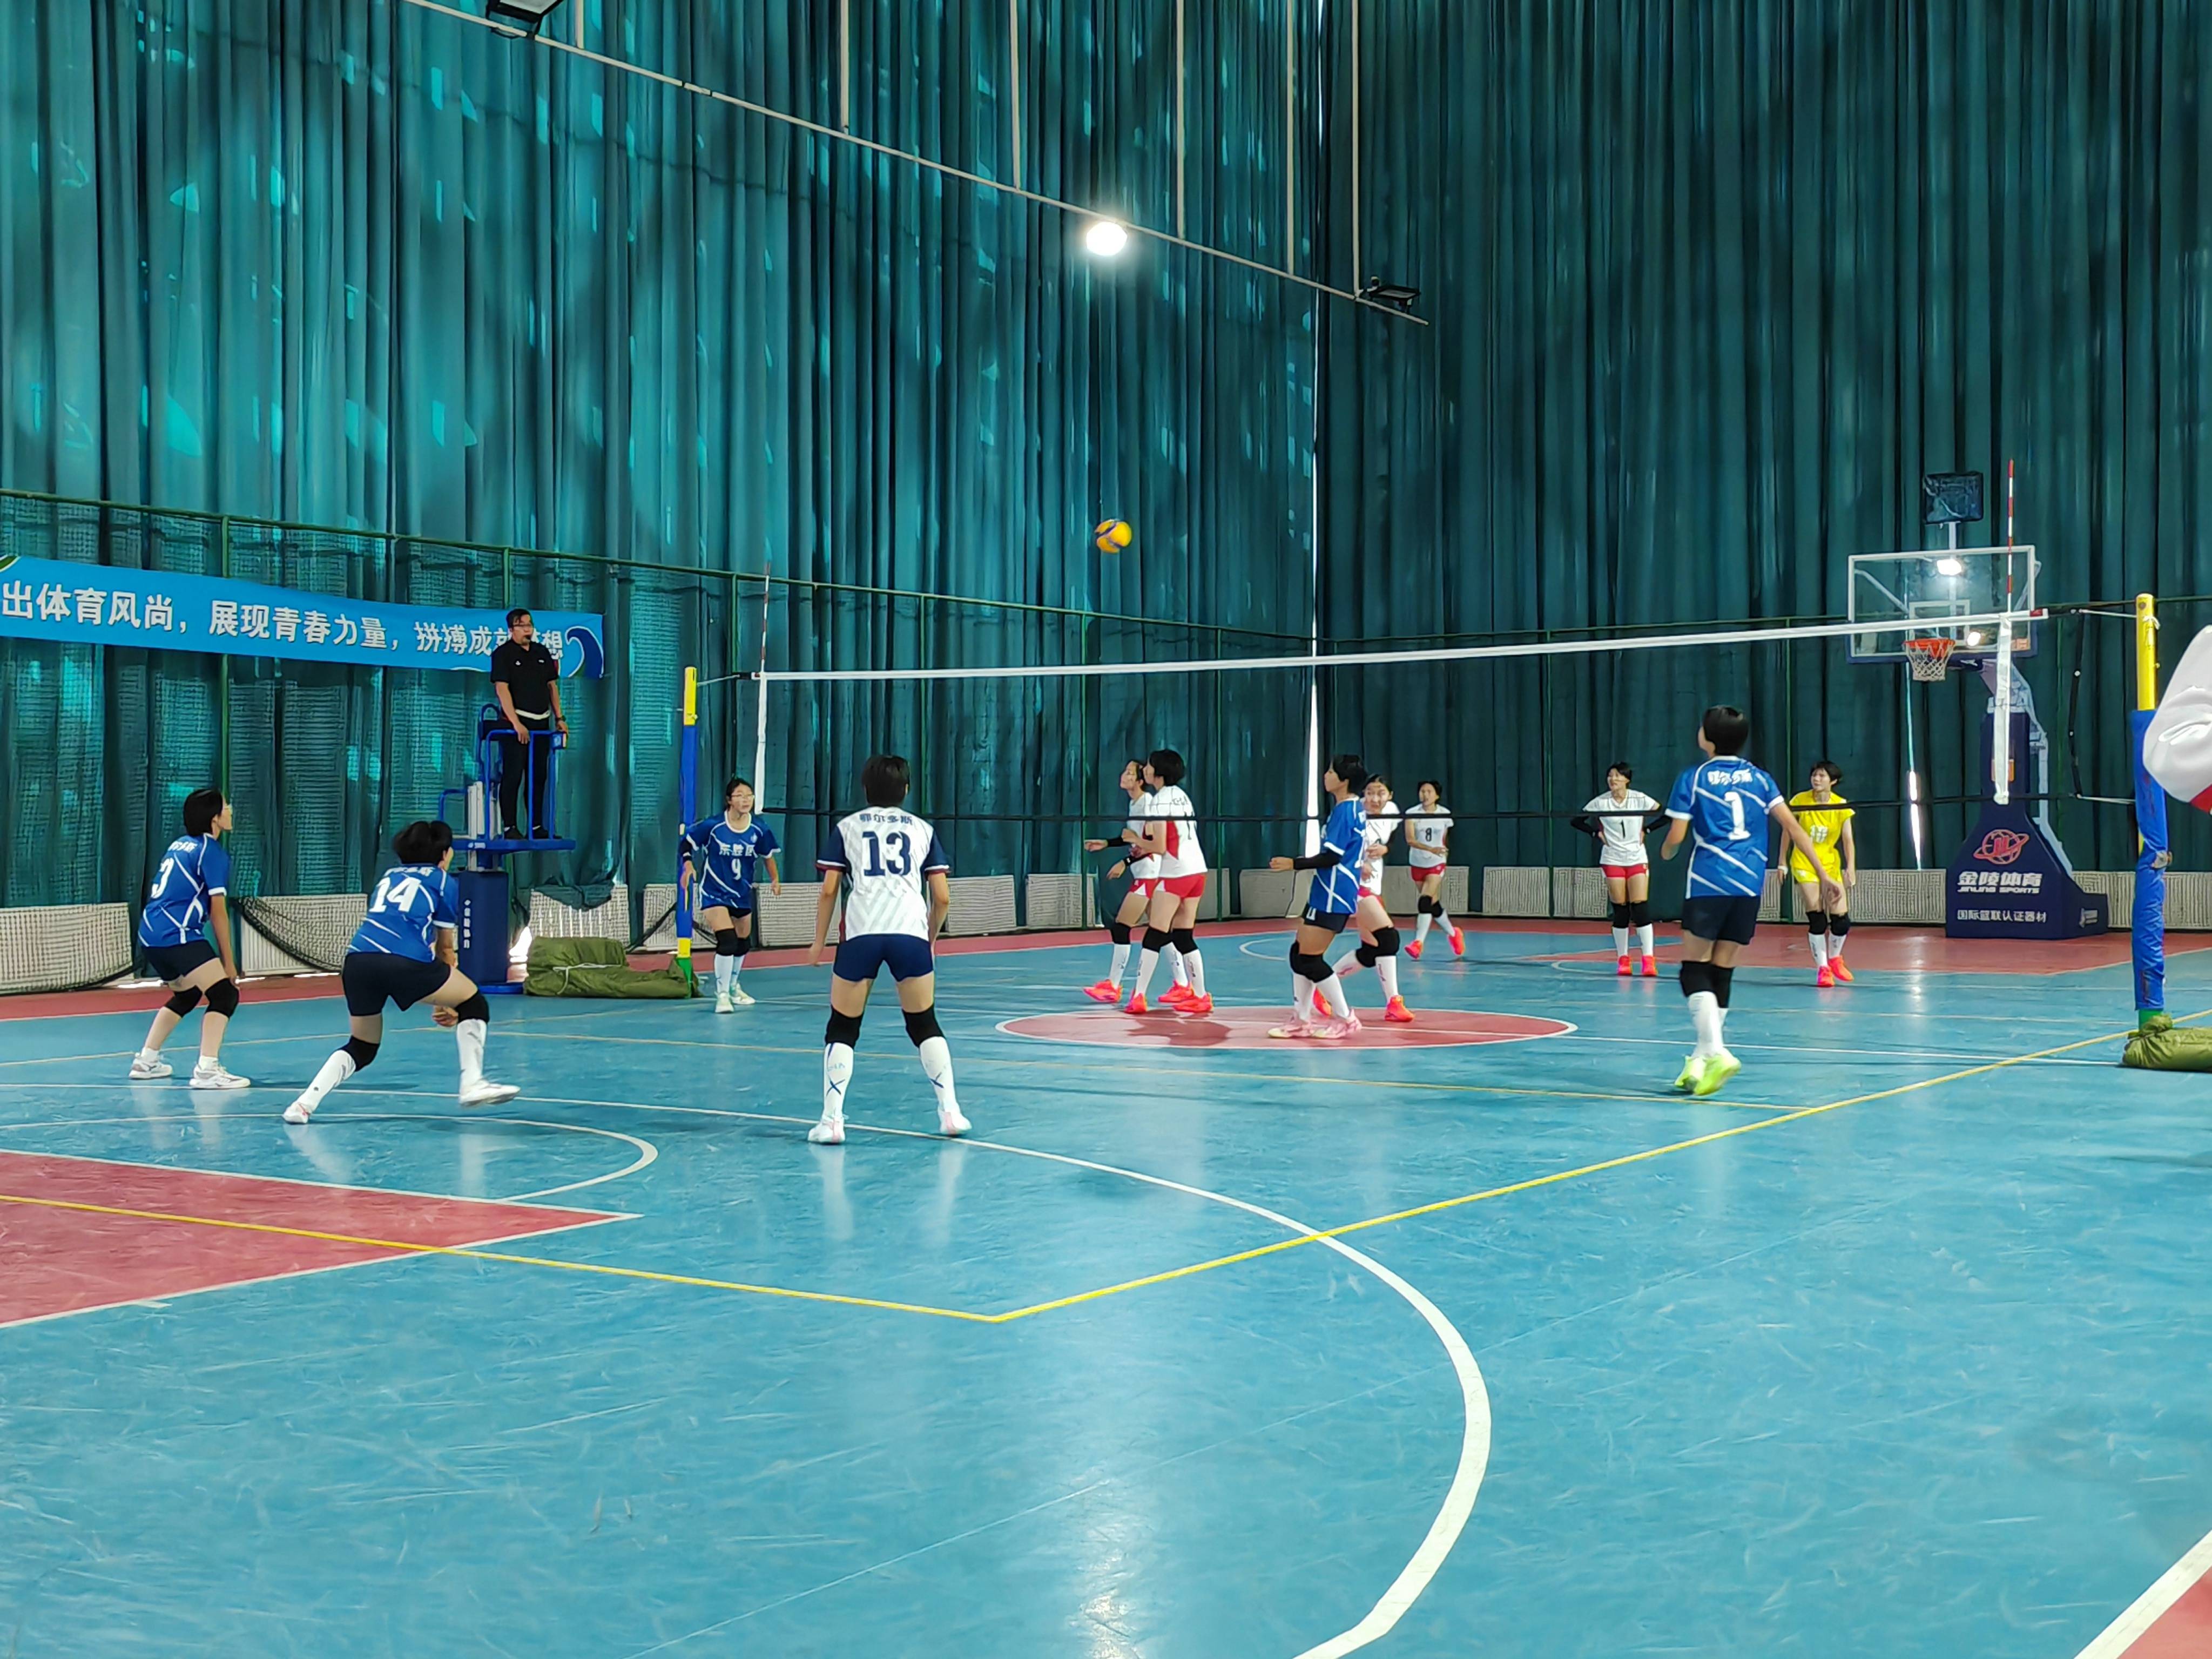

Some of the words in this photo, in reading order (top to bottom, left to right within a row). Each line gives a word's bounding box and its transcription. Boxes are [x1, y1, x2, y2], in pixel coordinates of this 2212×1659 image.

[1723, 791, 1751, 841] 1
[1425, 827, 1432, 842] 8
[862, 831, 911, 876] 13
[731, 858, 741, 880] 9
[1957, 871, 2043, 887] 金陵体育
[368, 877, 422, 913] 14
